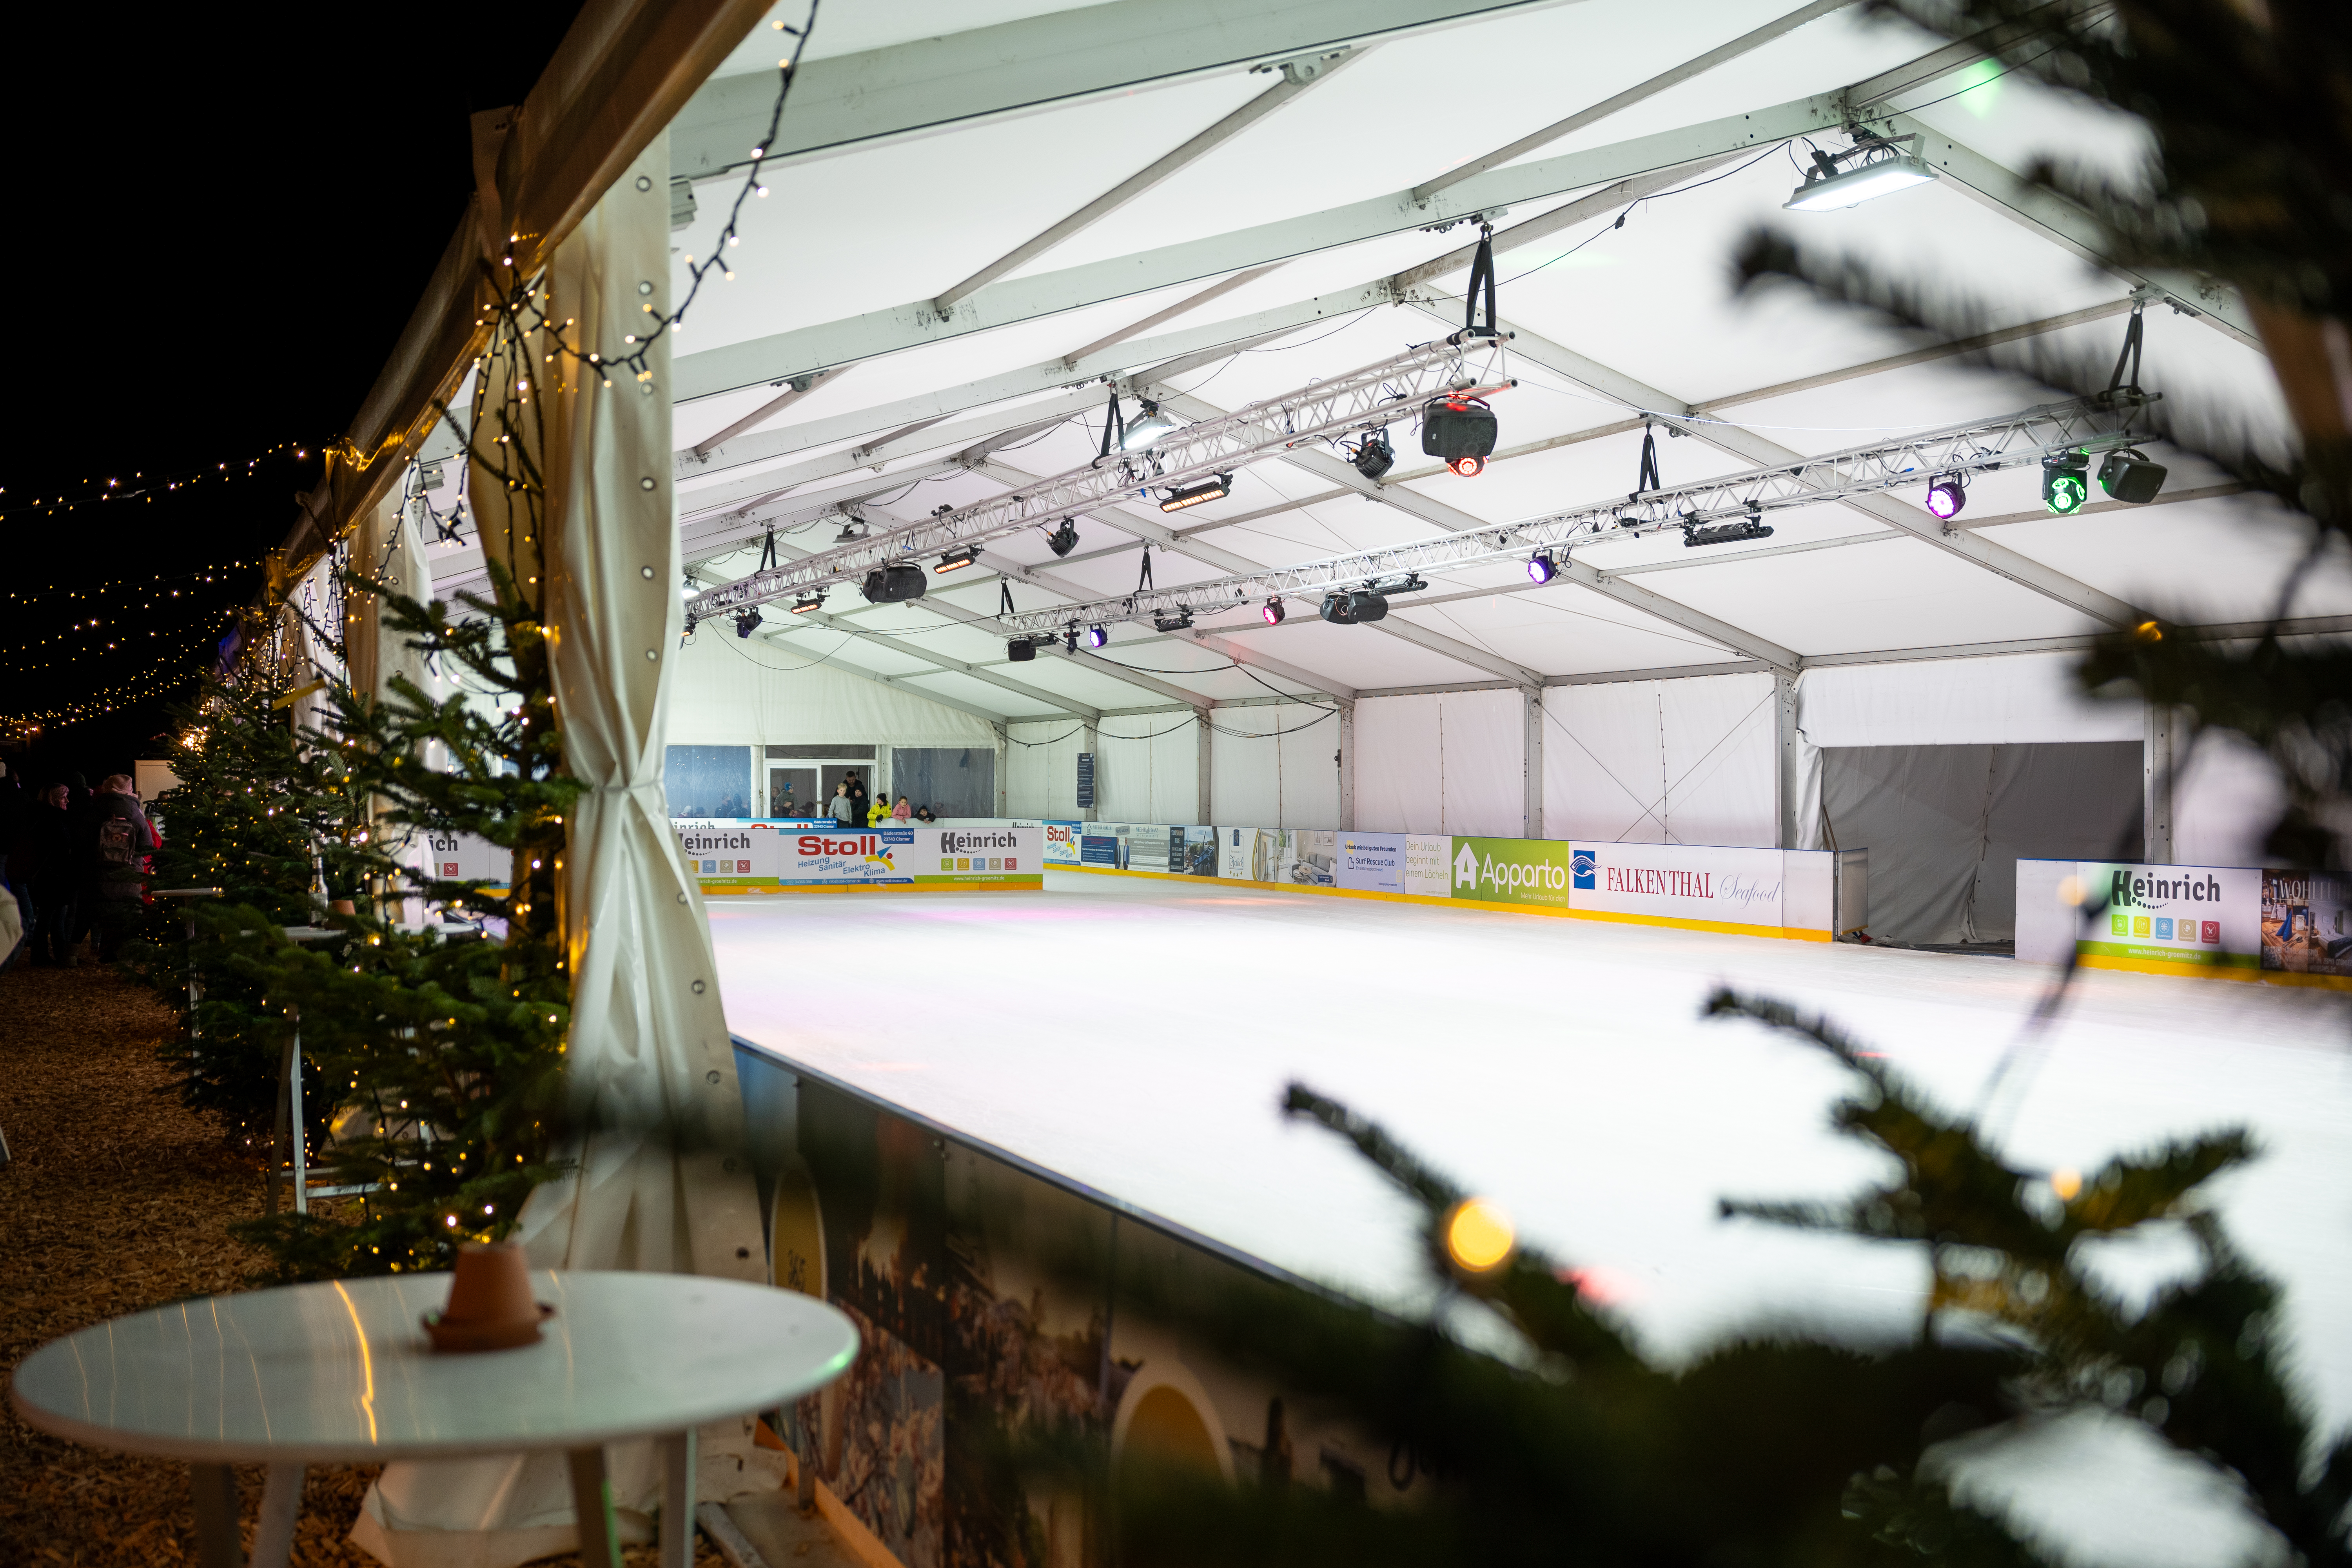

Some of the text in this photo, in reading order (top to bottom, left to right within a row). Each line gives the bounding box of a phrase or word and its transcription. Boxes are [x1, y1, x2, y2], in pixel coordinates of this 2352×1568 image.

[1047, 826, 1070, 842] Stoll
[798, 836, 875, 856] Stoll
[940, 832, 1017, 853] Heinrich
[1406, 840, 1441, 852] Dein Urlaub
[1053, 845, 1061, 853] Sanitär
[798, 857, 830, 868] Heizung
[818, 860, 846, 872] Sanitär
[1406, 854, 1439, 866] beginnt mit
[843, 864, 870, 875] Elektro
[864, 868, 885, 877] Klima
[1406, 868, 1450, 880] einem Lächeln.
[1481, 853, 1565, 895] Apparto
[1607, 867, 1780, 909] FALKENTHAL Seafood
[2111, 870, 2220, 906] Heinrich
[2128, 948, 2201, 960] www.heinrich-groemitz.de
